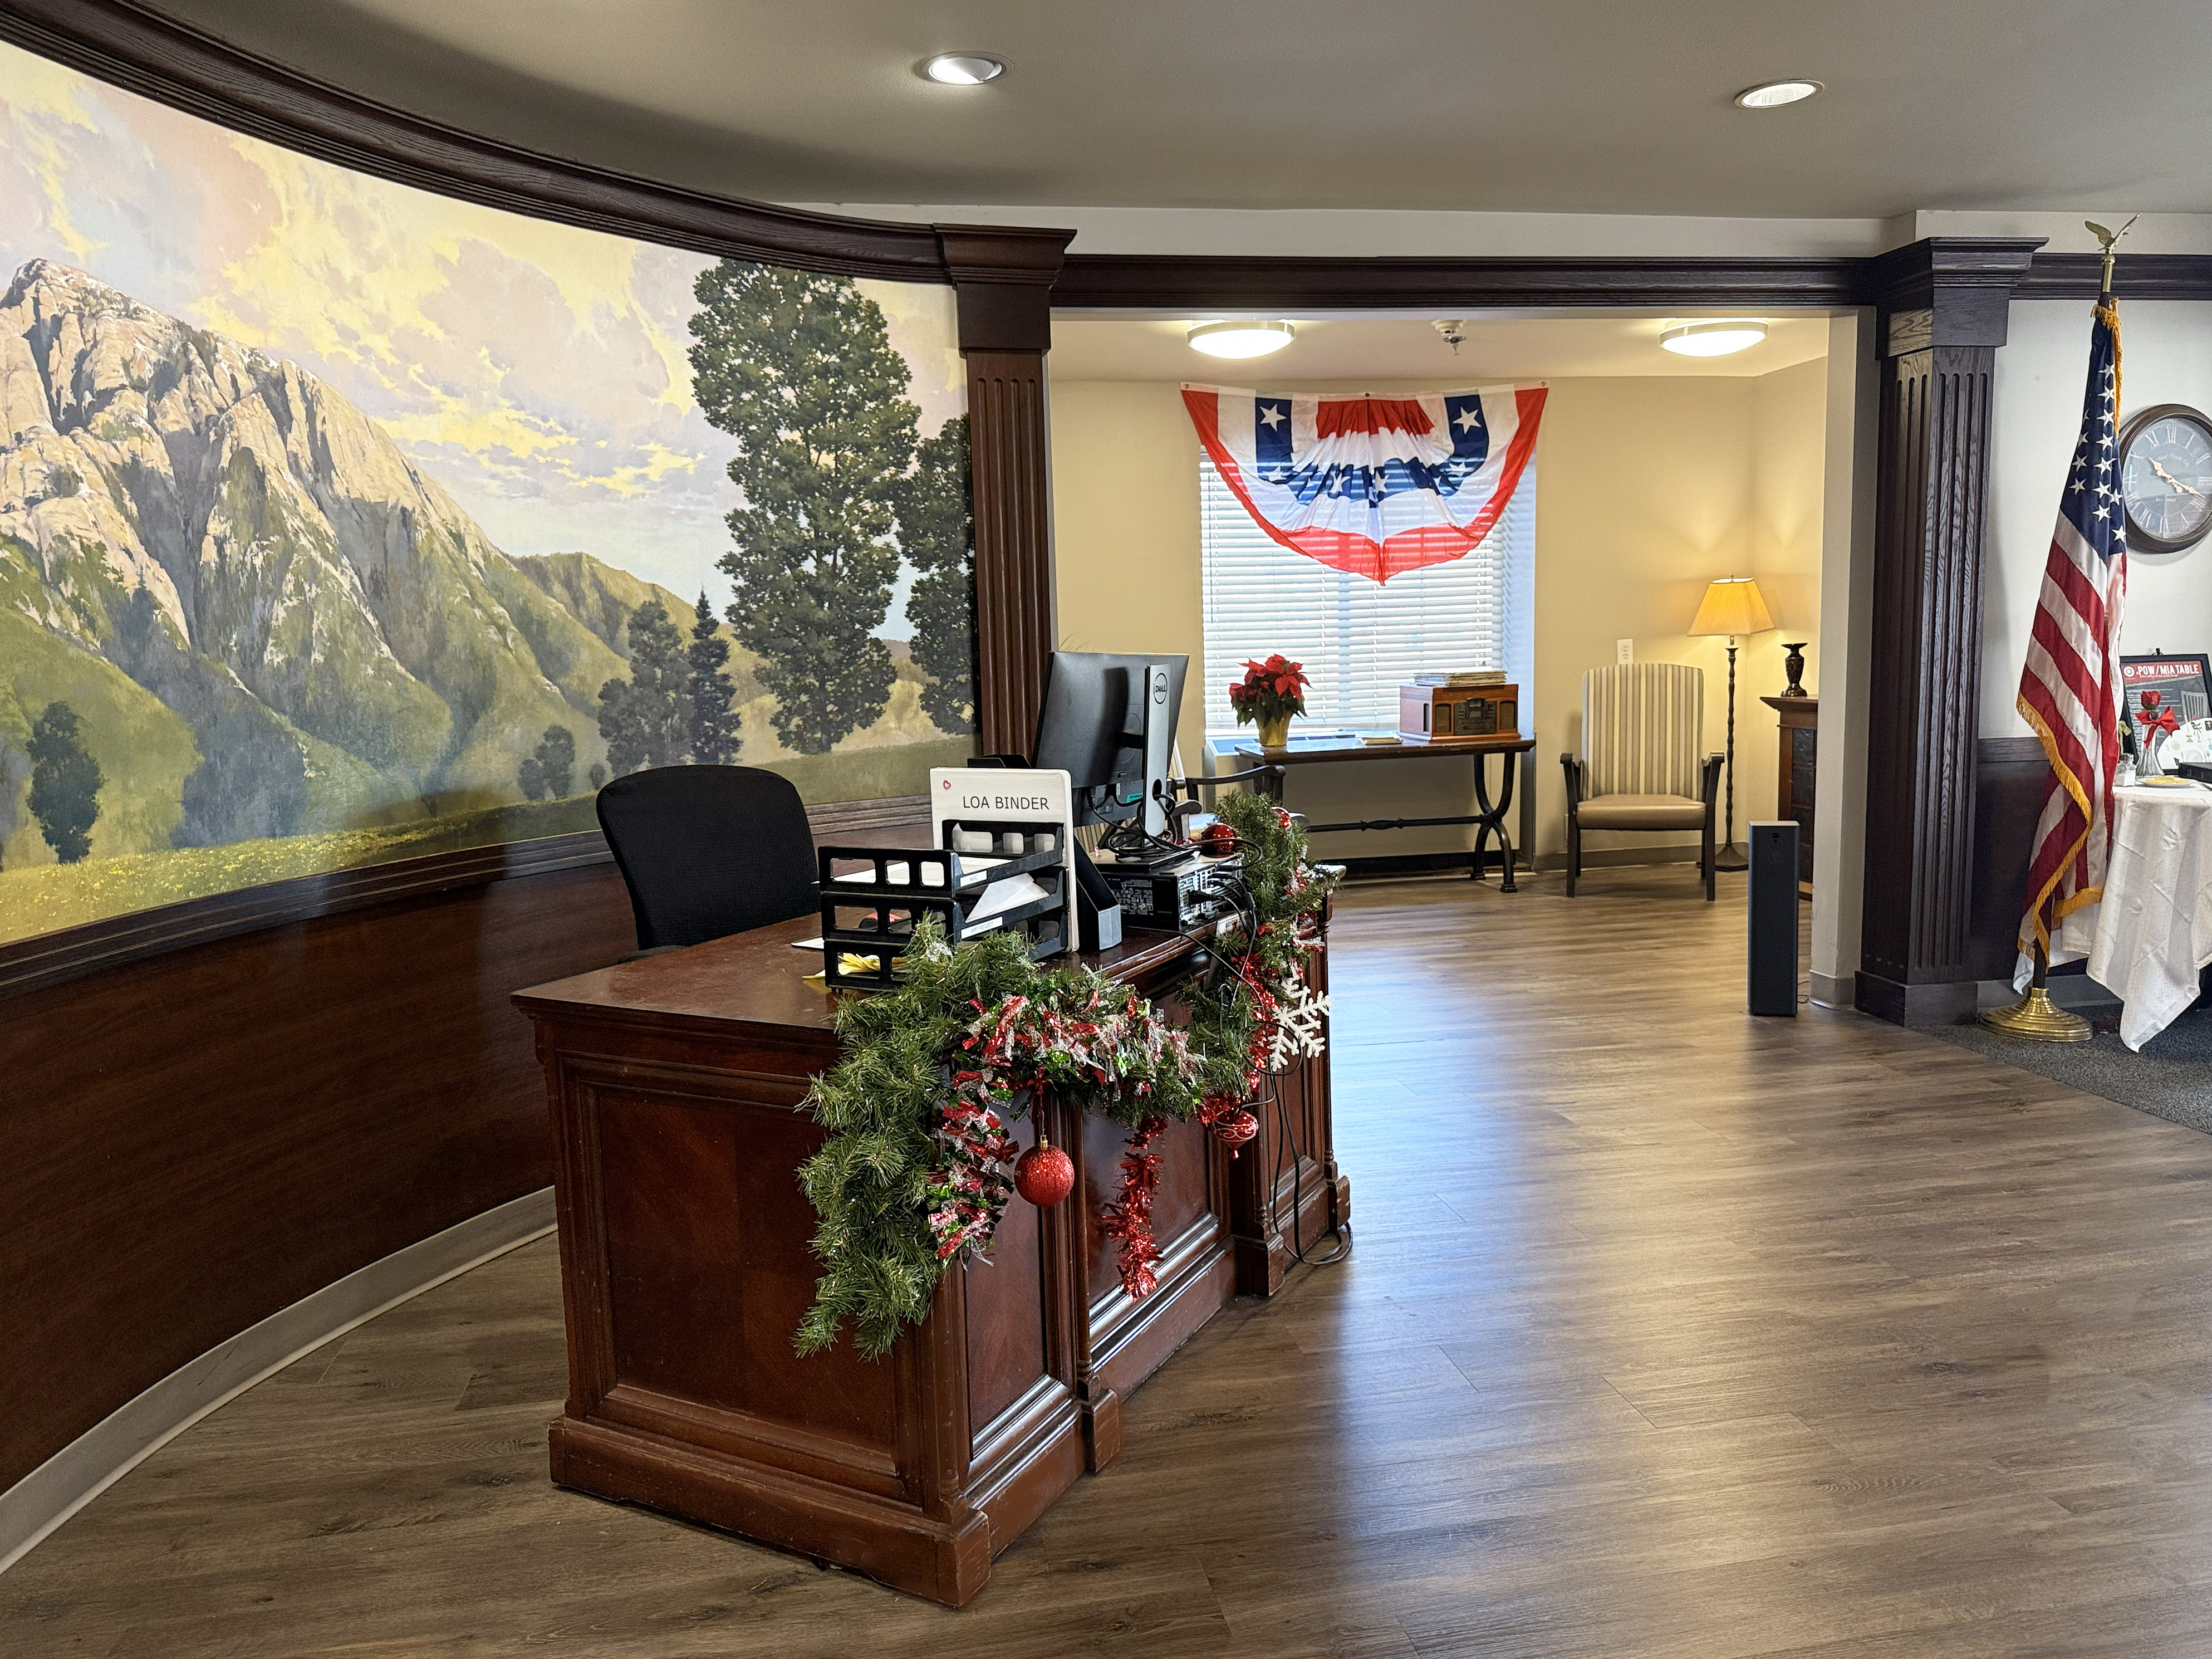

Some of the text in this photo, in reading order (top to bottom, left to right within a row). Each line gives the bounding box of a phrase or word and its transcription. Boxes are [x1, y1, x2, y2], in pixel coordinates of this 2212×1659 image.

[2175, 664, 2200, 674] TABLE
[1155, 684, 1166, 693] DELL
[963, 796, 1049, 810] LOA BINDER
